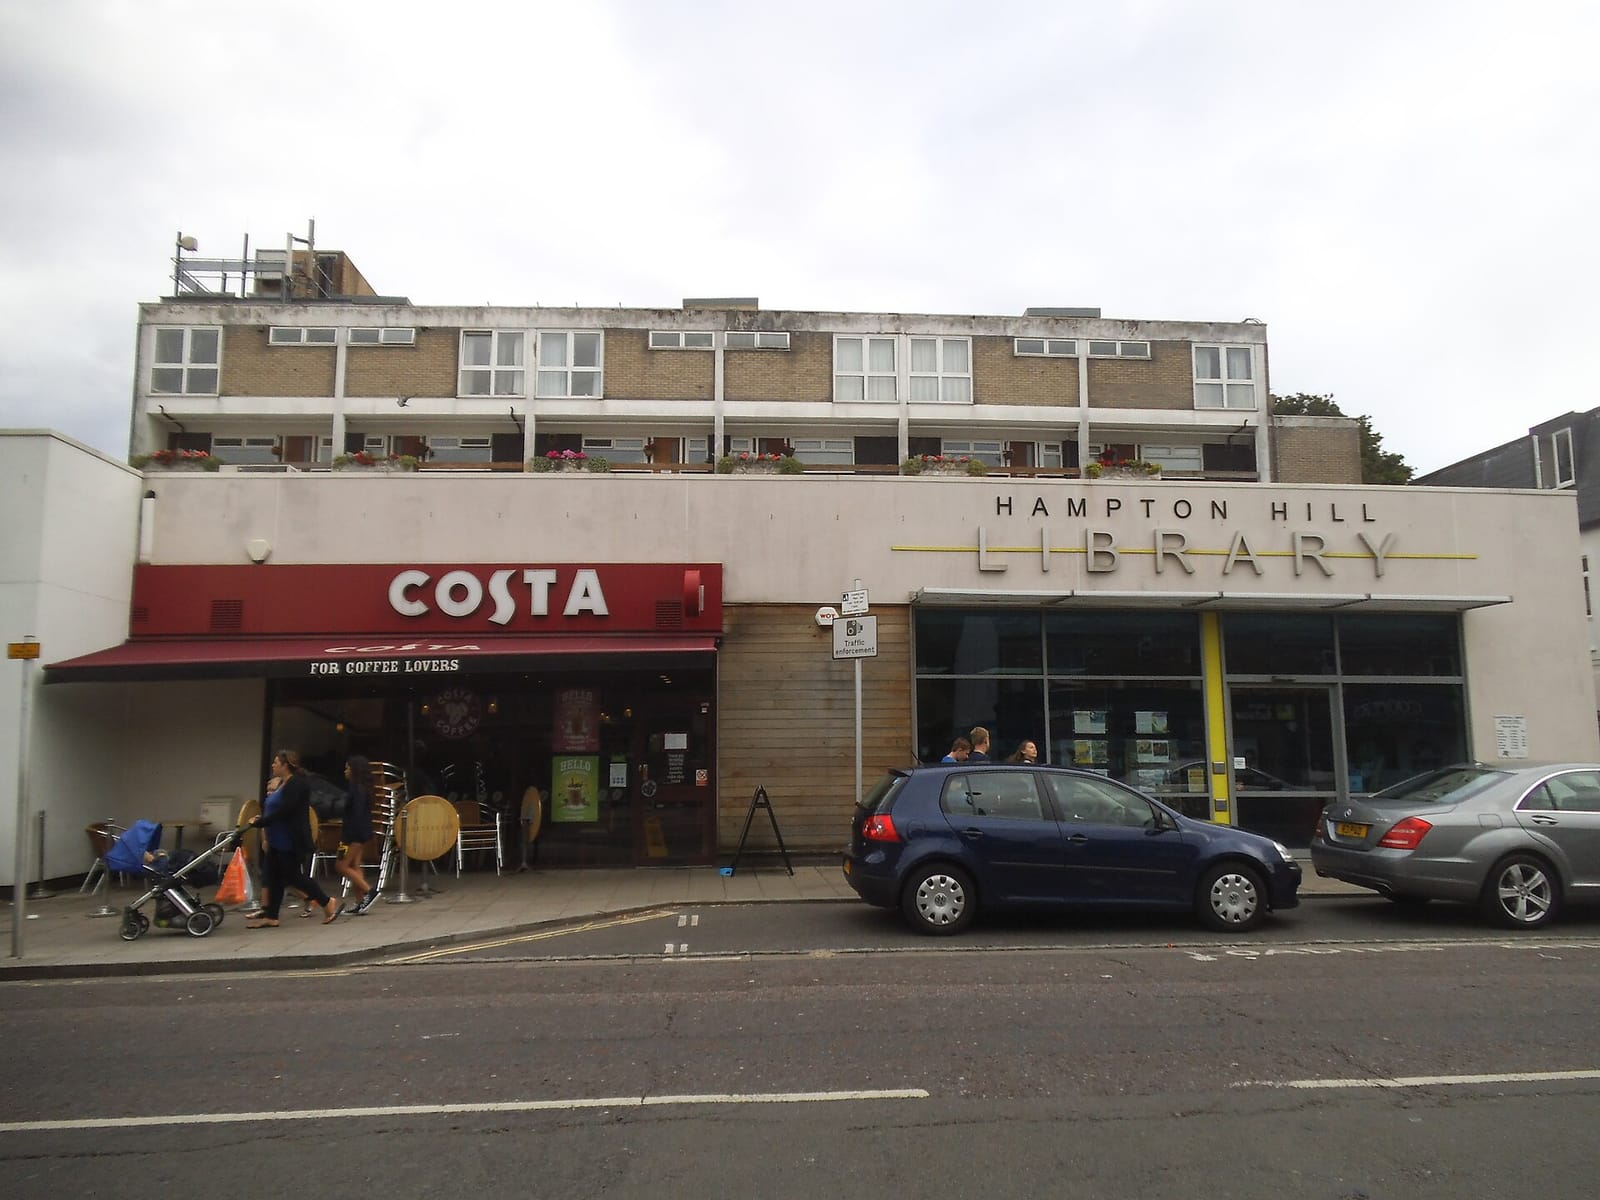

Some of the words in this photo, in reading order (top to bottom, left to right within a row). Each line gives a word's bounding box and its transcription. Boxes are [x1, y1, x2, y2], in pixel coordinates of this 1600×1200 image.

[996, 496, 1228, 520] HAMPTON
[1271, 502, 1377, 521] HILL
[978, 526, 1397, 577] LIBRARY
[388, 569, 609, 625] COSTA
[324, 643, 481, 653] COSTA
[835, 647, 875, 655] enforcement
[310, 662, 339, 675] FOR
[345, 661, 399, 674] COFFEE
[404, 659, 459, 673] LOVERS
[560, 758, 592, 772] HELLO
